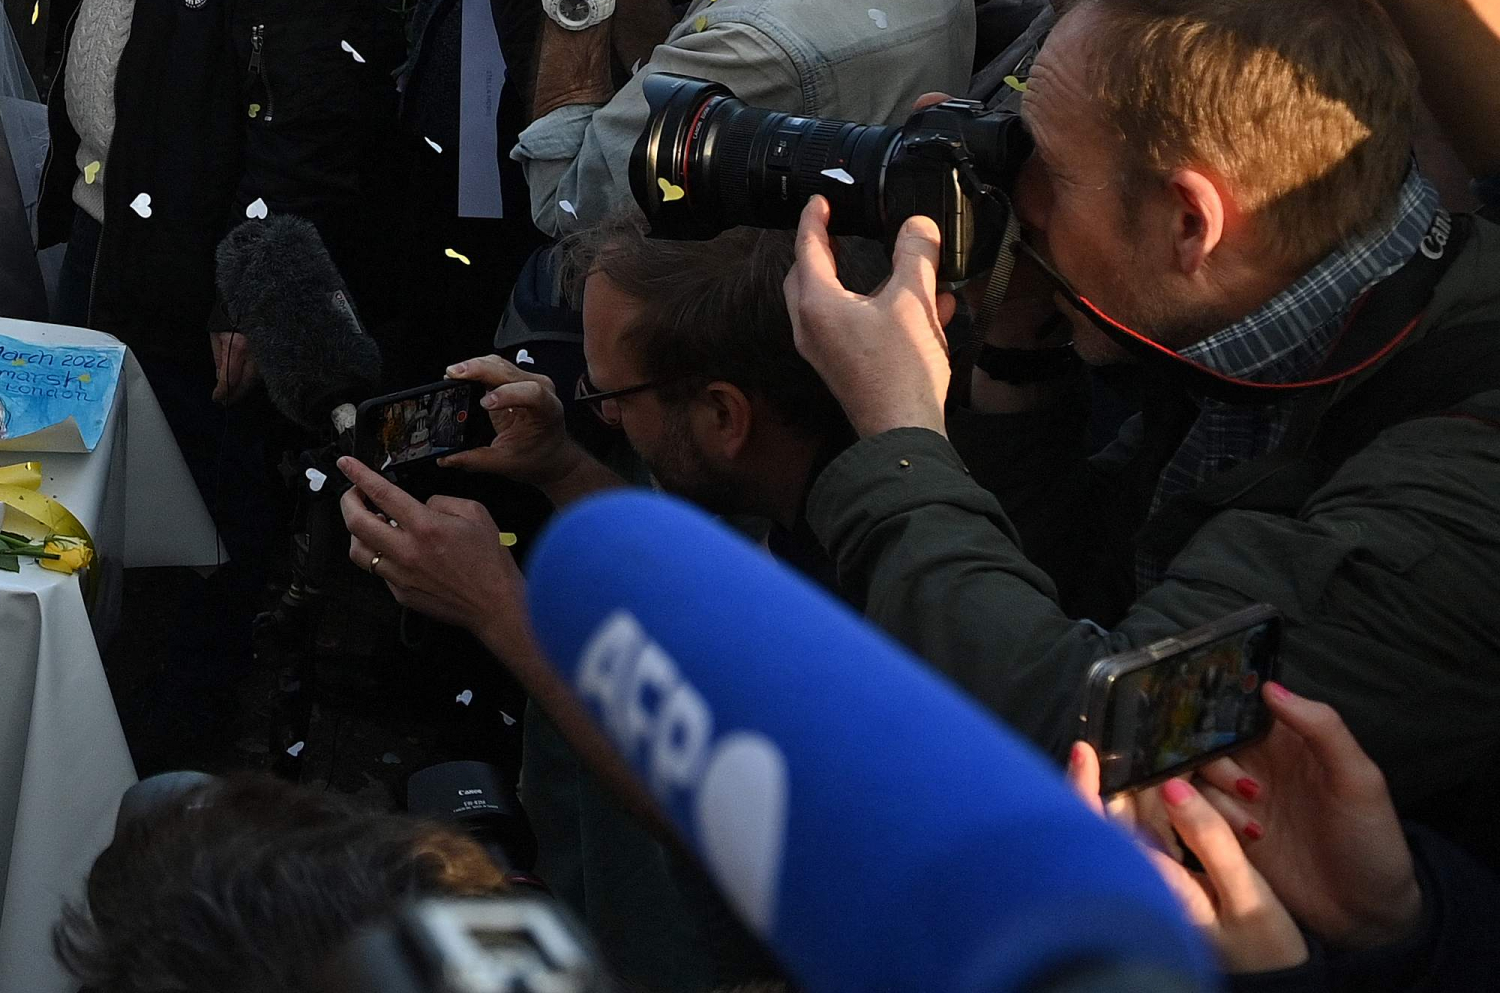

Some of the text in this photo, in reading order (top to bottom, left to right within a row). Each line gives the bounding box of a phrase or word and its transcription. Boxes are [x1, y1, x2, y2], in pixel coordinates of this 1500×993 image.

[61, 354, 111, 369] 2022
[5, 383, 98, 402] London
[578, 609, 714, 799] AFP
